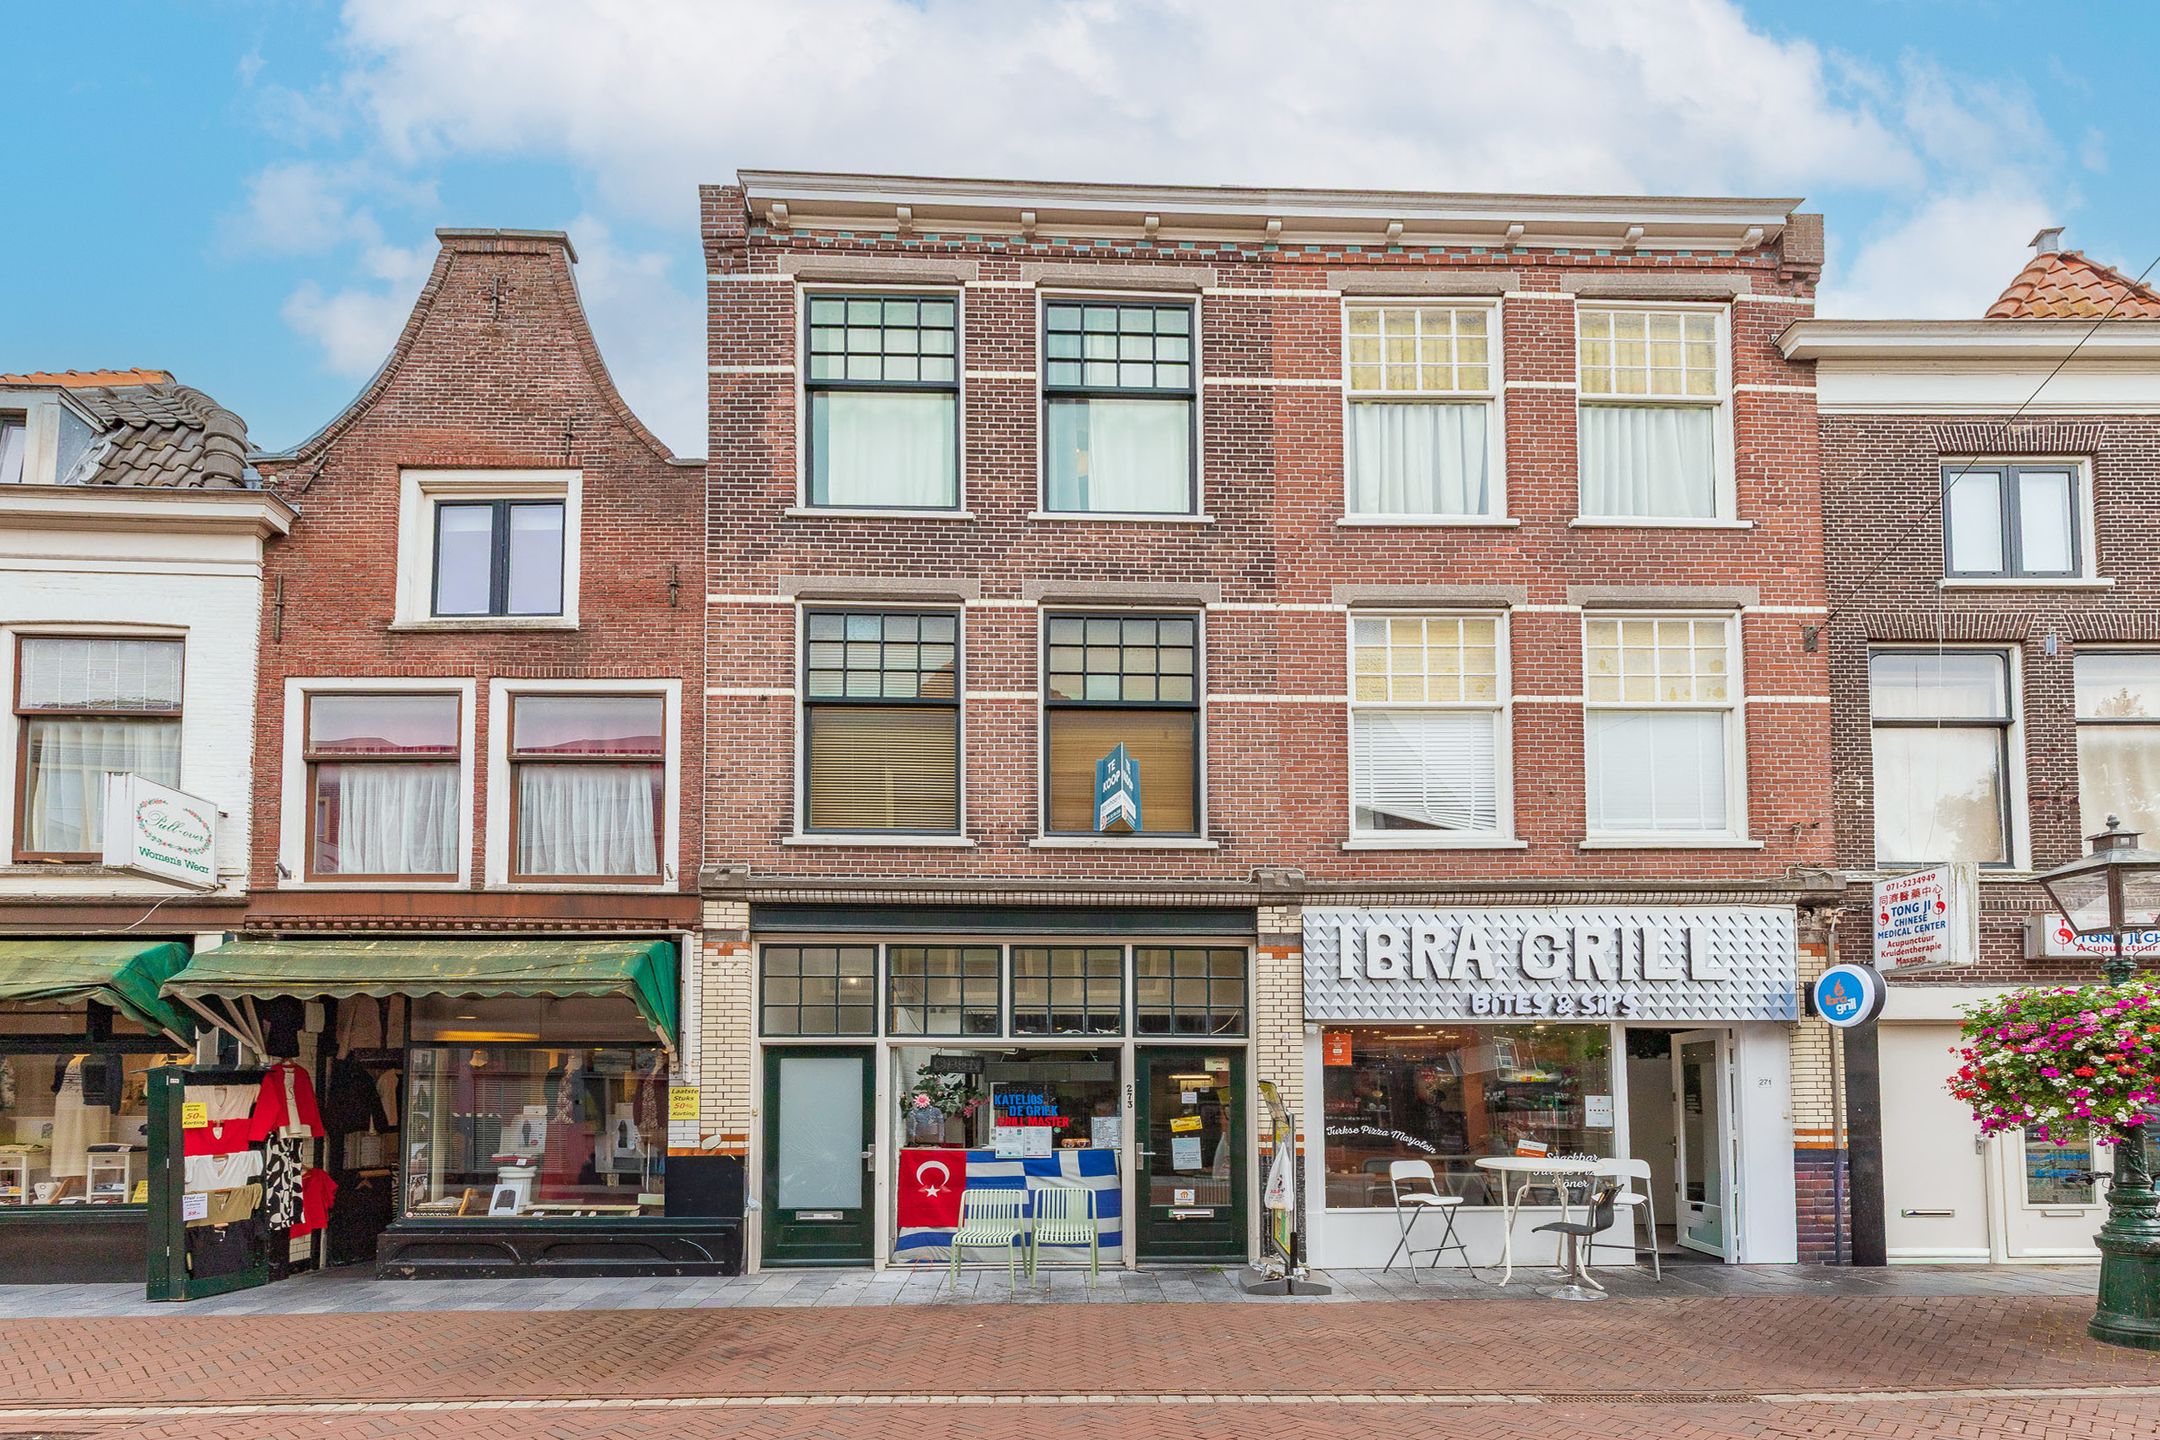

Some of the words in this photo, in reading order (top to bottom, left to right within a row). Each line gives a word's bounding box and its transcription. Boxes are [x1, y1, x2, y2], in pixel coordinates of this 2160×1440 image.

[1107, 759, 1116, 774] TE
[1103, 770, 1121, 792] KOOP
[148, 810, 204, 842] Pull-over
[138, 846, 182, 866] Women's
[184, 859, 209, 873] Wear
[1886, 873, 1936, 892] 071-5234949
[1891, 902, 1920, 917] TONG
[1923, 900, 1931, 914] JI
[1894, 914, 1928, 927] CHINESE
[1877, 928, 1912, 940] MEDICAL
[1914, 920, 1946, 933] CENTER
[1881, 943, 1942, 958] Kruidentherapie
[1887, 935, 1935, 949] Acupunctuur
[2077, 943, 2158, 954] Acupuctuur
[1337, 924, 1496, 981] IBRA
[1520, 924, 1728, 982] GRILL
[1896, 955, 1926, 966] Massage
[1555, 993, 1577, 1015] &
[1836, 997, 1857, 1015] grill
[1009, 1106, 1024, 1117] DE
[1026, 1106, 1058, 1117] GRIEK
[997, 1117, 1025, 1127] GRILL
[1027, 1117, 1070, 1128] MASTER
[1326, 1126, 1360, 1135] Turkse
[1361, 1125, 1389, 1136] Pizza
[1391, 1130, 1436, 1154] Marjolein
